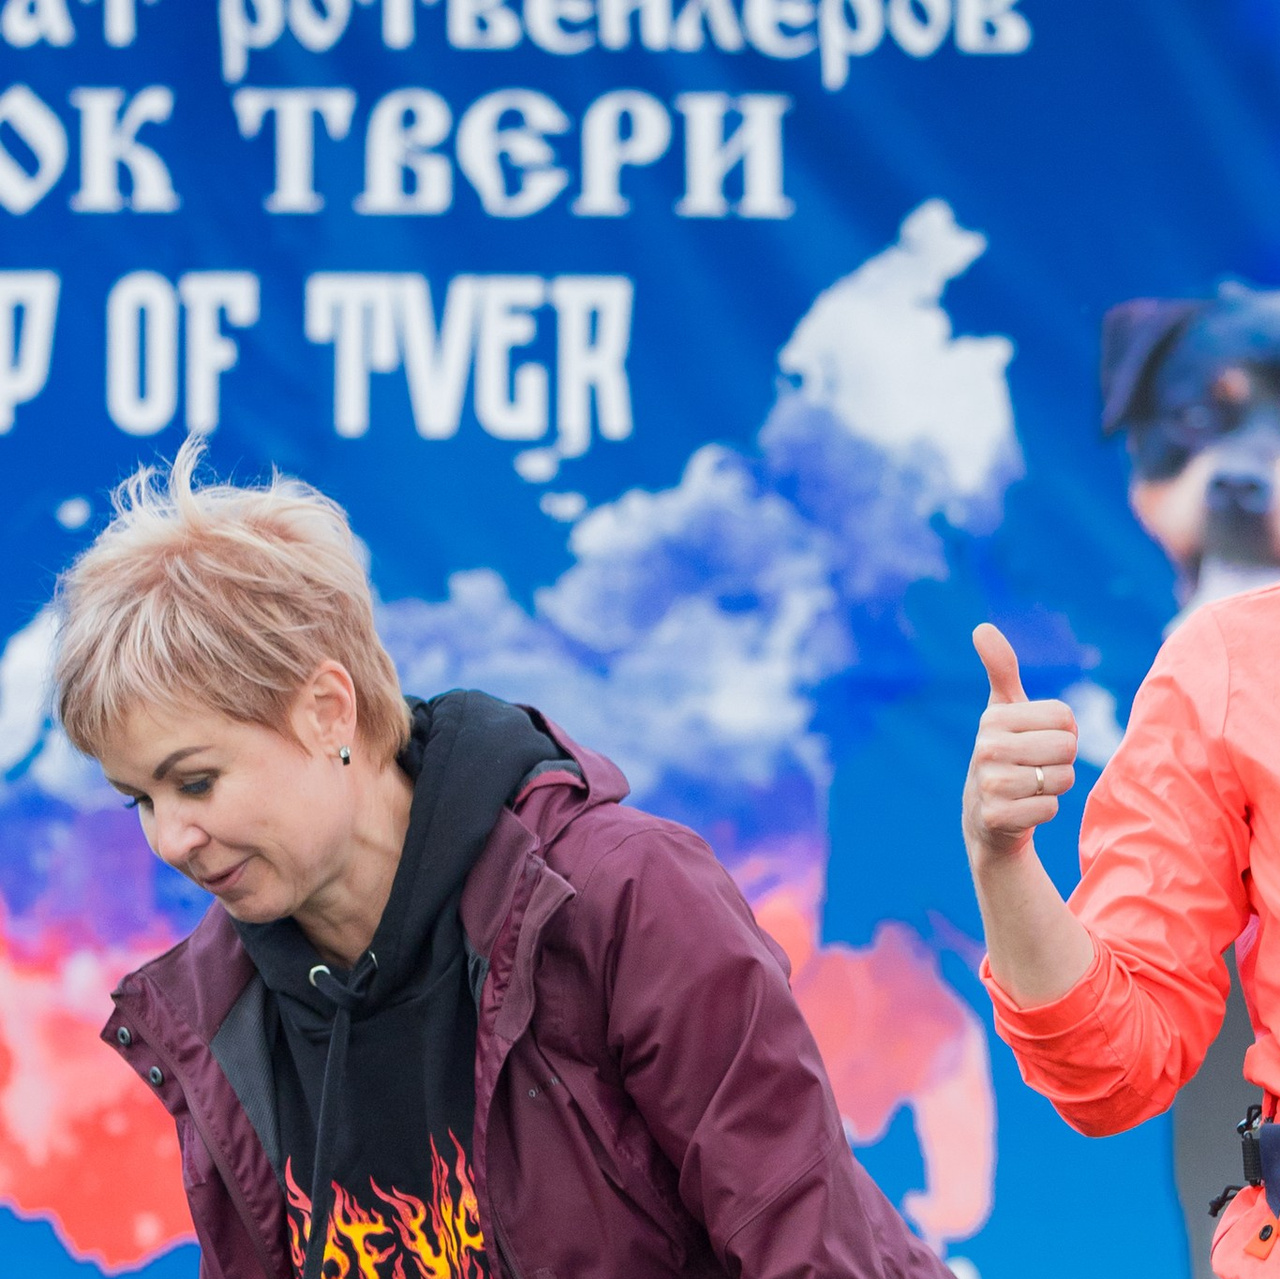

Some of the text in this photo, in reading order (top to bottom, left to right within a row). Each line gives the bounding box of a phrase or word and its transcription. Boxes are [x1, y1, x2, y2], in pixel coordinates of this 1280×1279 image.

[232, 86, 796, 219] ТВЕРИ
[105, 269, 262, 437] OF
[304, 271, 636, 458] TVER
